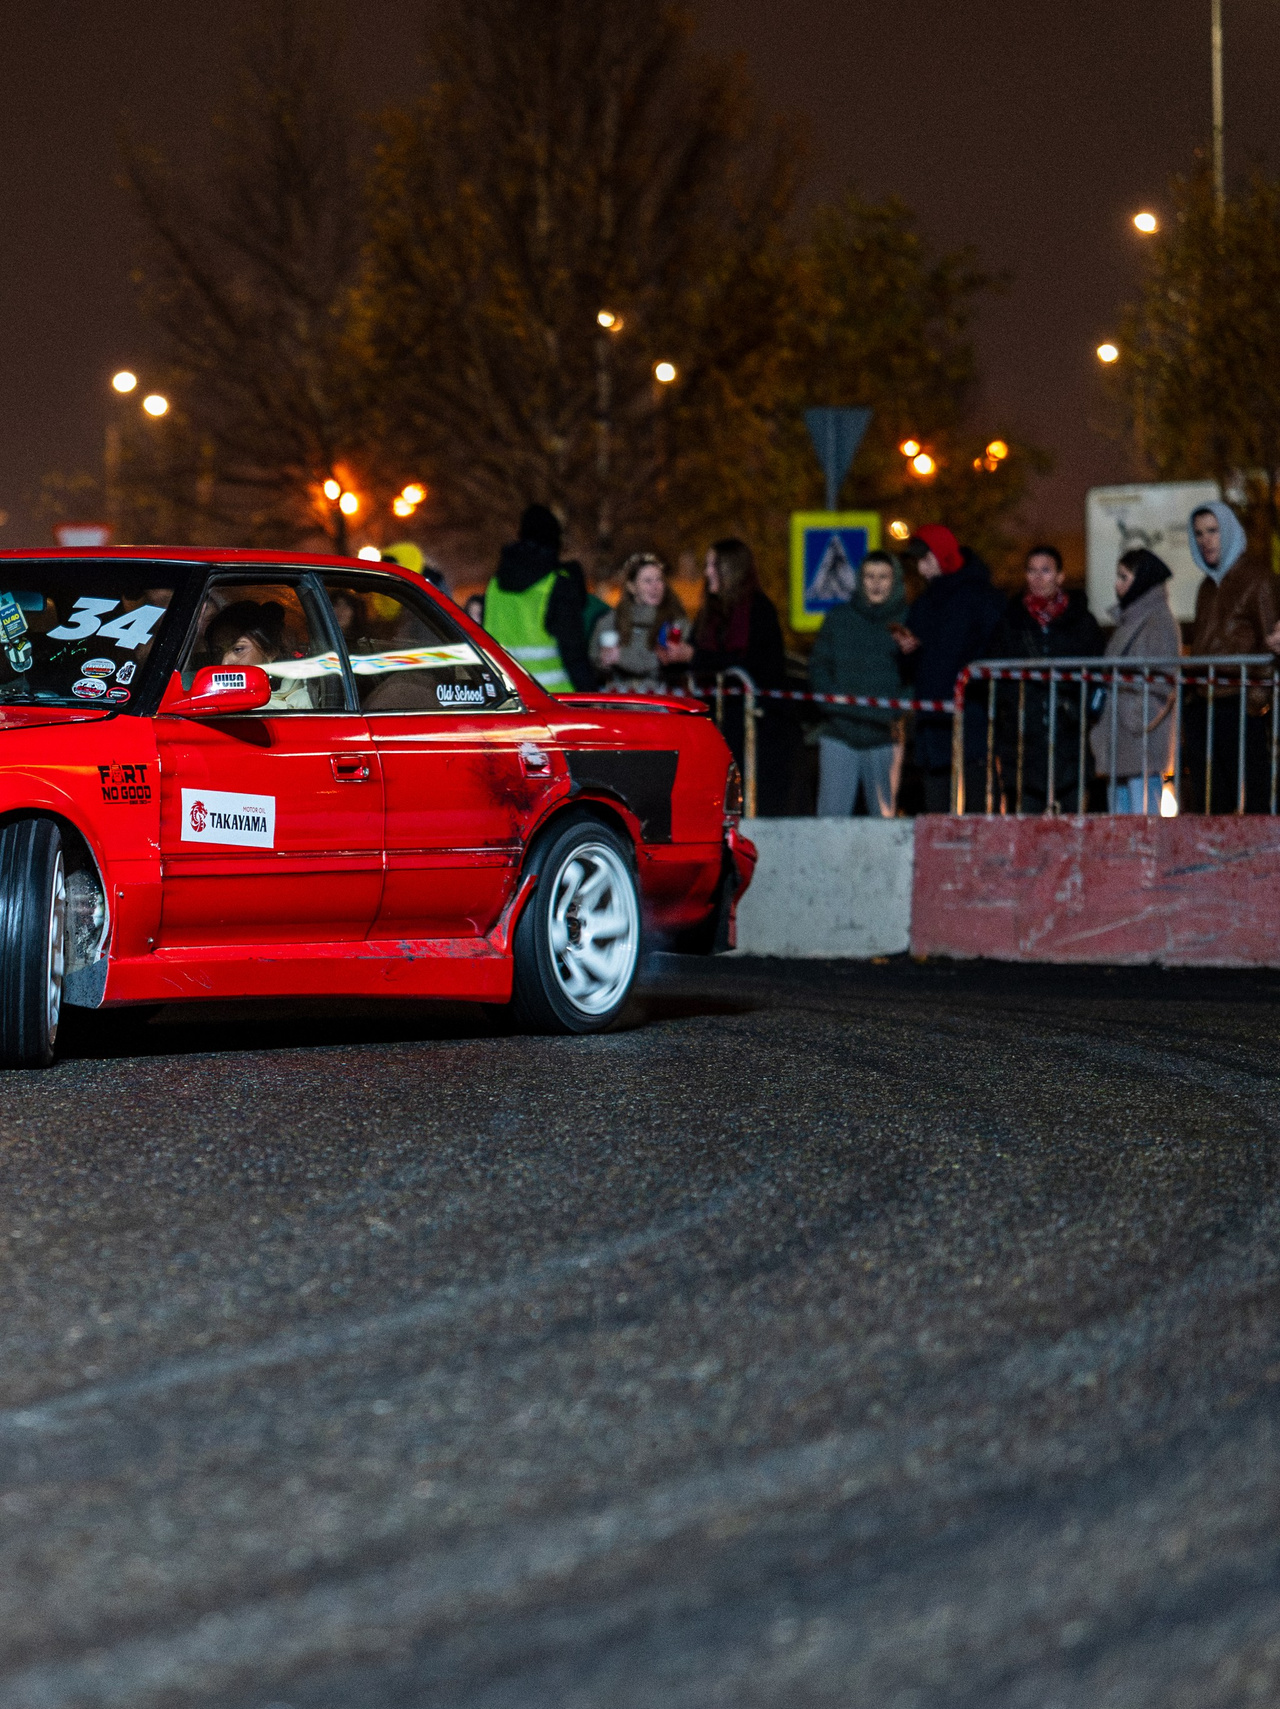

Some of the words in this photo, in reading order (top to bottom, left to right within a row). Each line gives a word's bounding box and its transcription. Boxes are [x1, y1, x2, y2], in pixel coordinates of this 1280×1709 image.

[46, 597, 167, 650] 34
[436, 684, 454, 701] Old
[455, 685, 484, 702] School
[101, 786, 119, 800] NO
[121, 785, 151, 799] GOOD
[210, 812, 267, 832] TAKAYAMA
